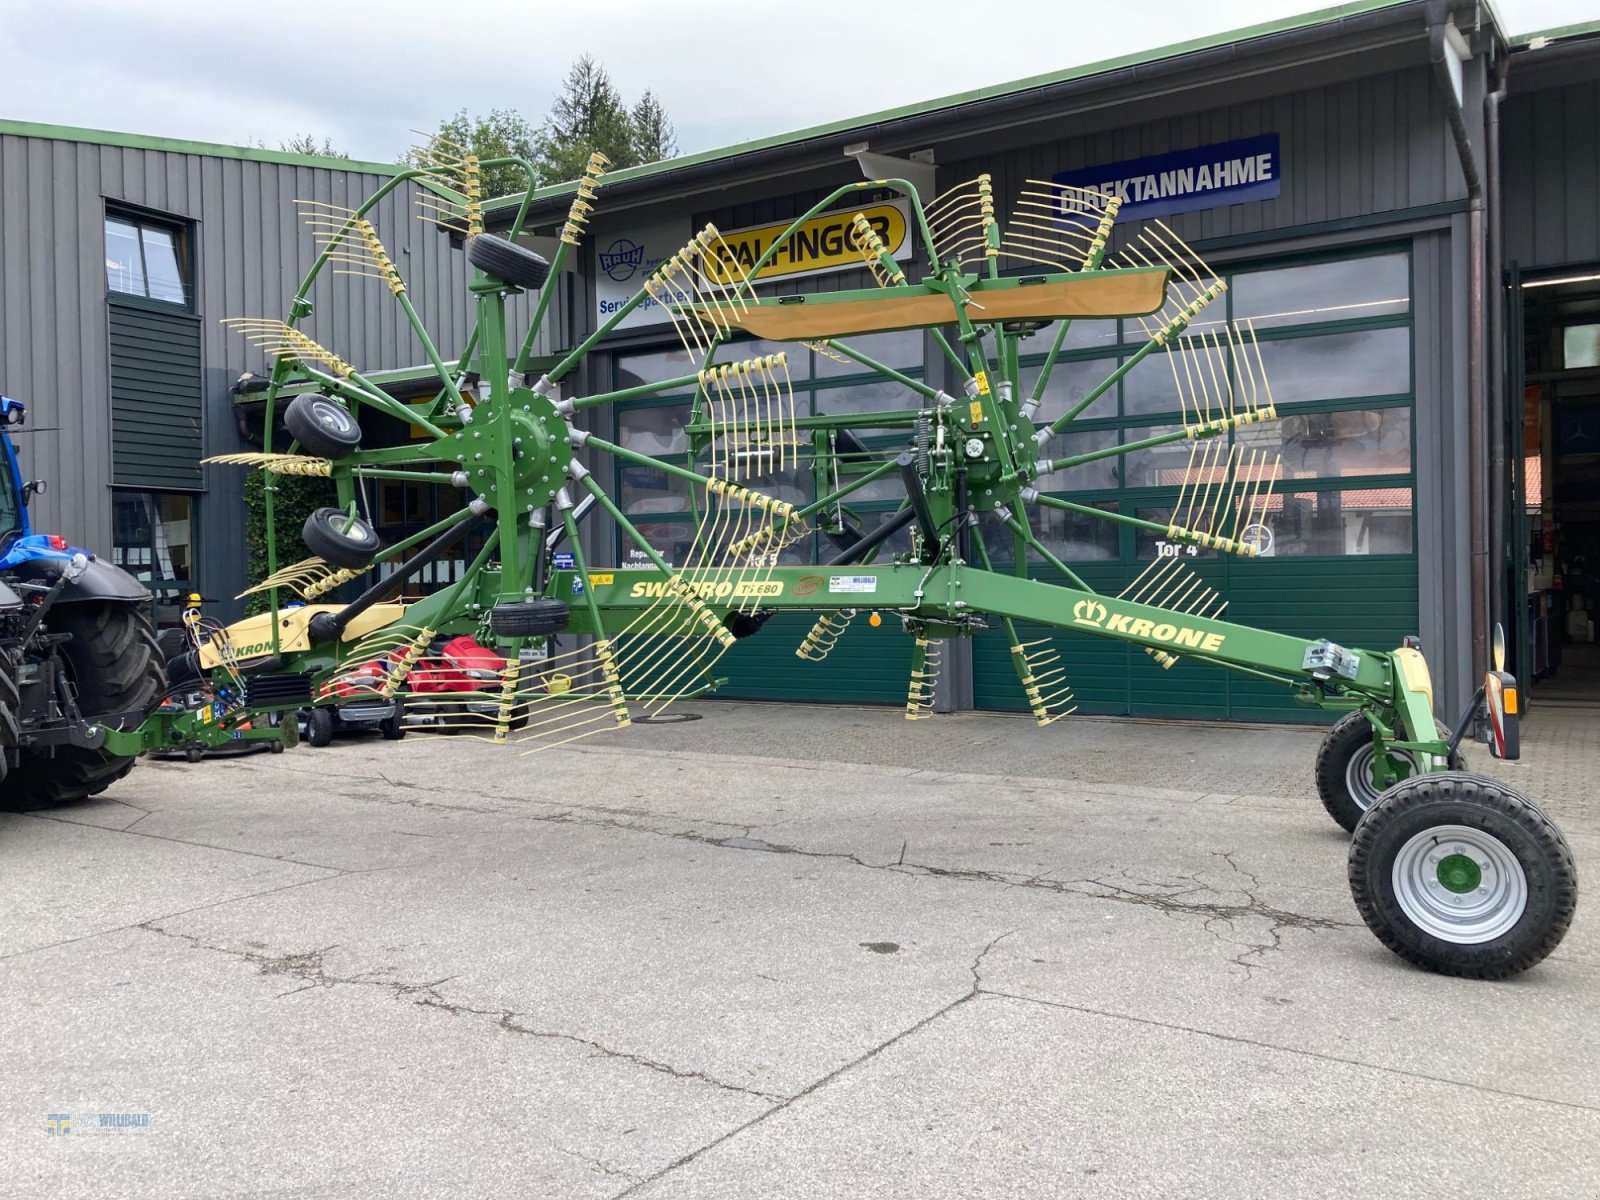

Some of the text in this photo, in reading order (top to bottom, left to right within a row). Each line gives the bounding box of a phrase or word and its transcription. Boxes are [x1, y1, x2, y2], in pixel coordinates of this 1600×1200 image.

[1060, 153, 1272, 215] DIREKTANNAHME
[1155, 541, 1198, 557] Tor 4
[757, 584, 778, 594] 680
[1105, 612, 1226, 652] KRONE
